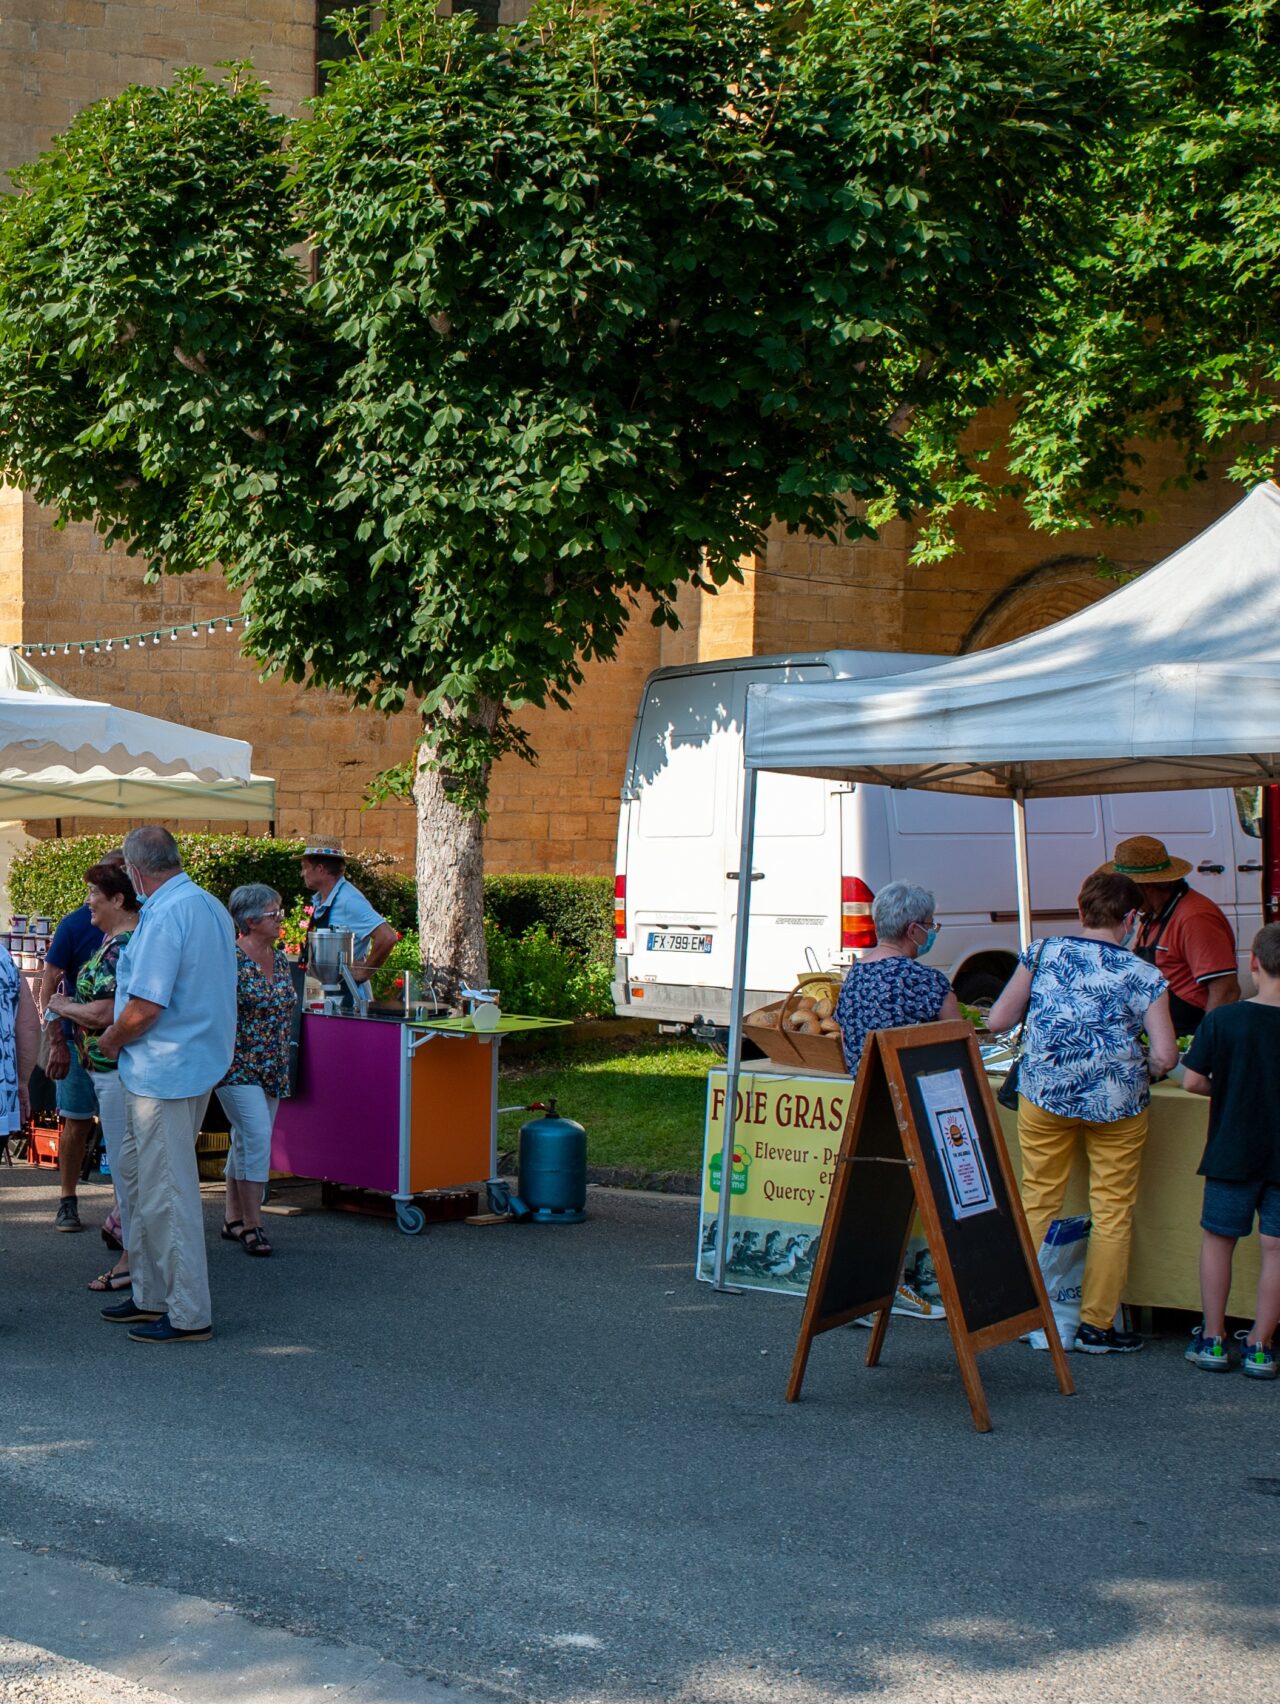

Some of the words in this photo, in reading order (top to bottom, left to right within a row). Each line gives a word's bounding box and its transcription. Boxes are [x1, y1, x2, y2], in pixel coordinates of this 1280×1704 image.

[652, 935, 705, 951] FX-799-EM
[775, 1093, 844, 1132] GRAS
[754, 1141, 810, 1163] Eleveur
[763, 1179, 816, 1207] Quercy
